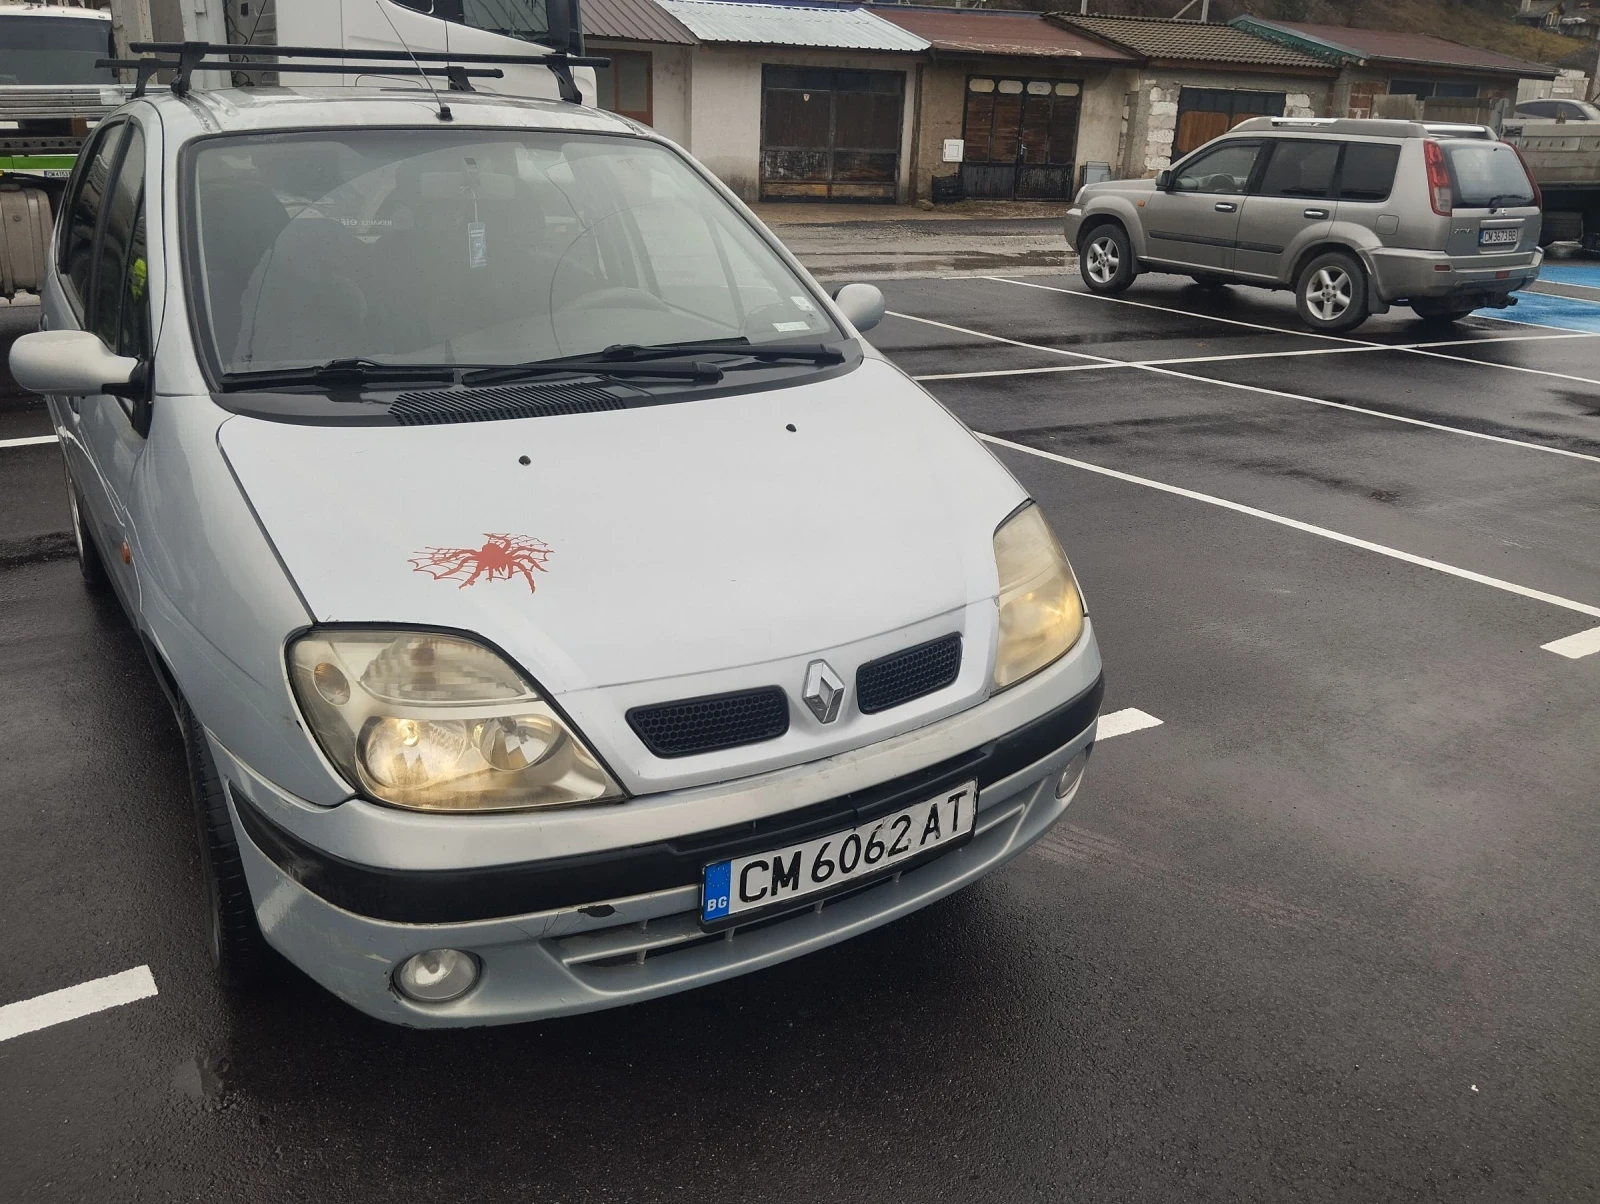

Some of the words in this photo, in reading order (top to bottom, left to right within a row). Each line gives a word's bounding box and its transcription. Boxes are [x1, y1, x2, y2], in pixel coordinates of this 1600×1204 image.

[1493, 231, 1508, 242] 3673
[739, 850, 802, 903] CM
[810, 814, 912, 884] 6062
[919, 790, 969, 846] AT
[706, 895, 728, 912] BG
